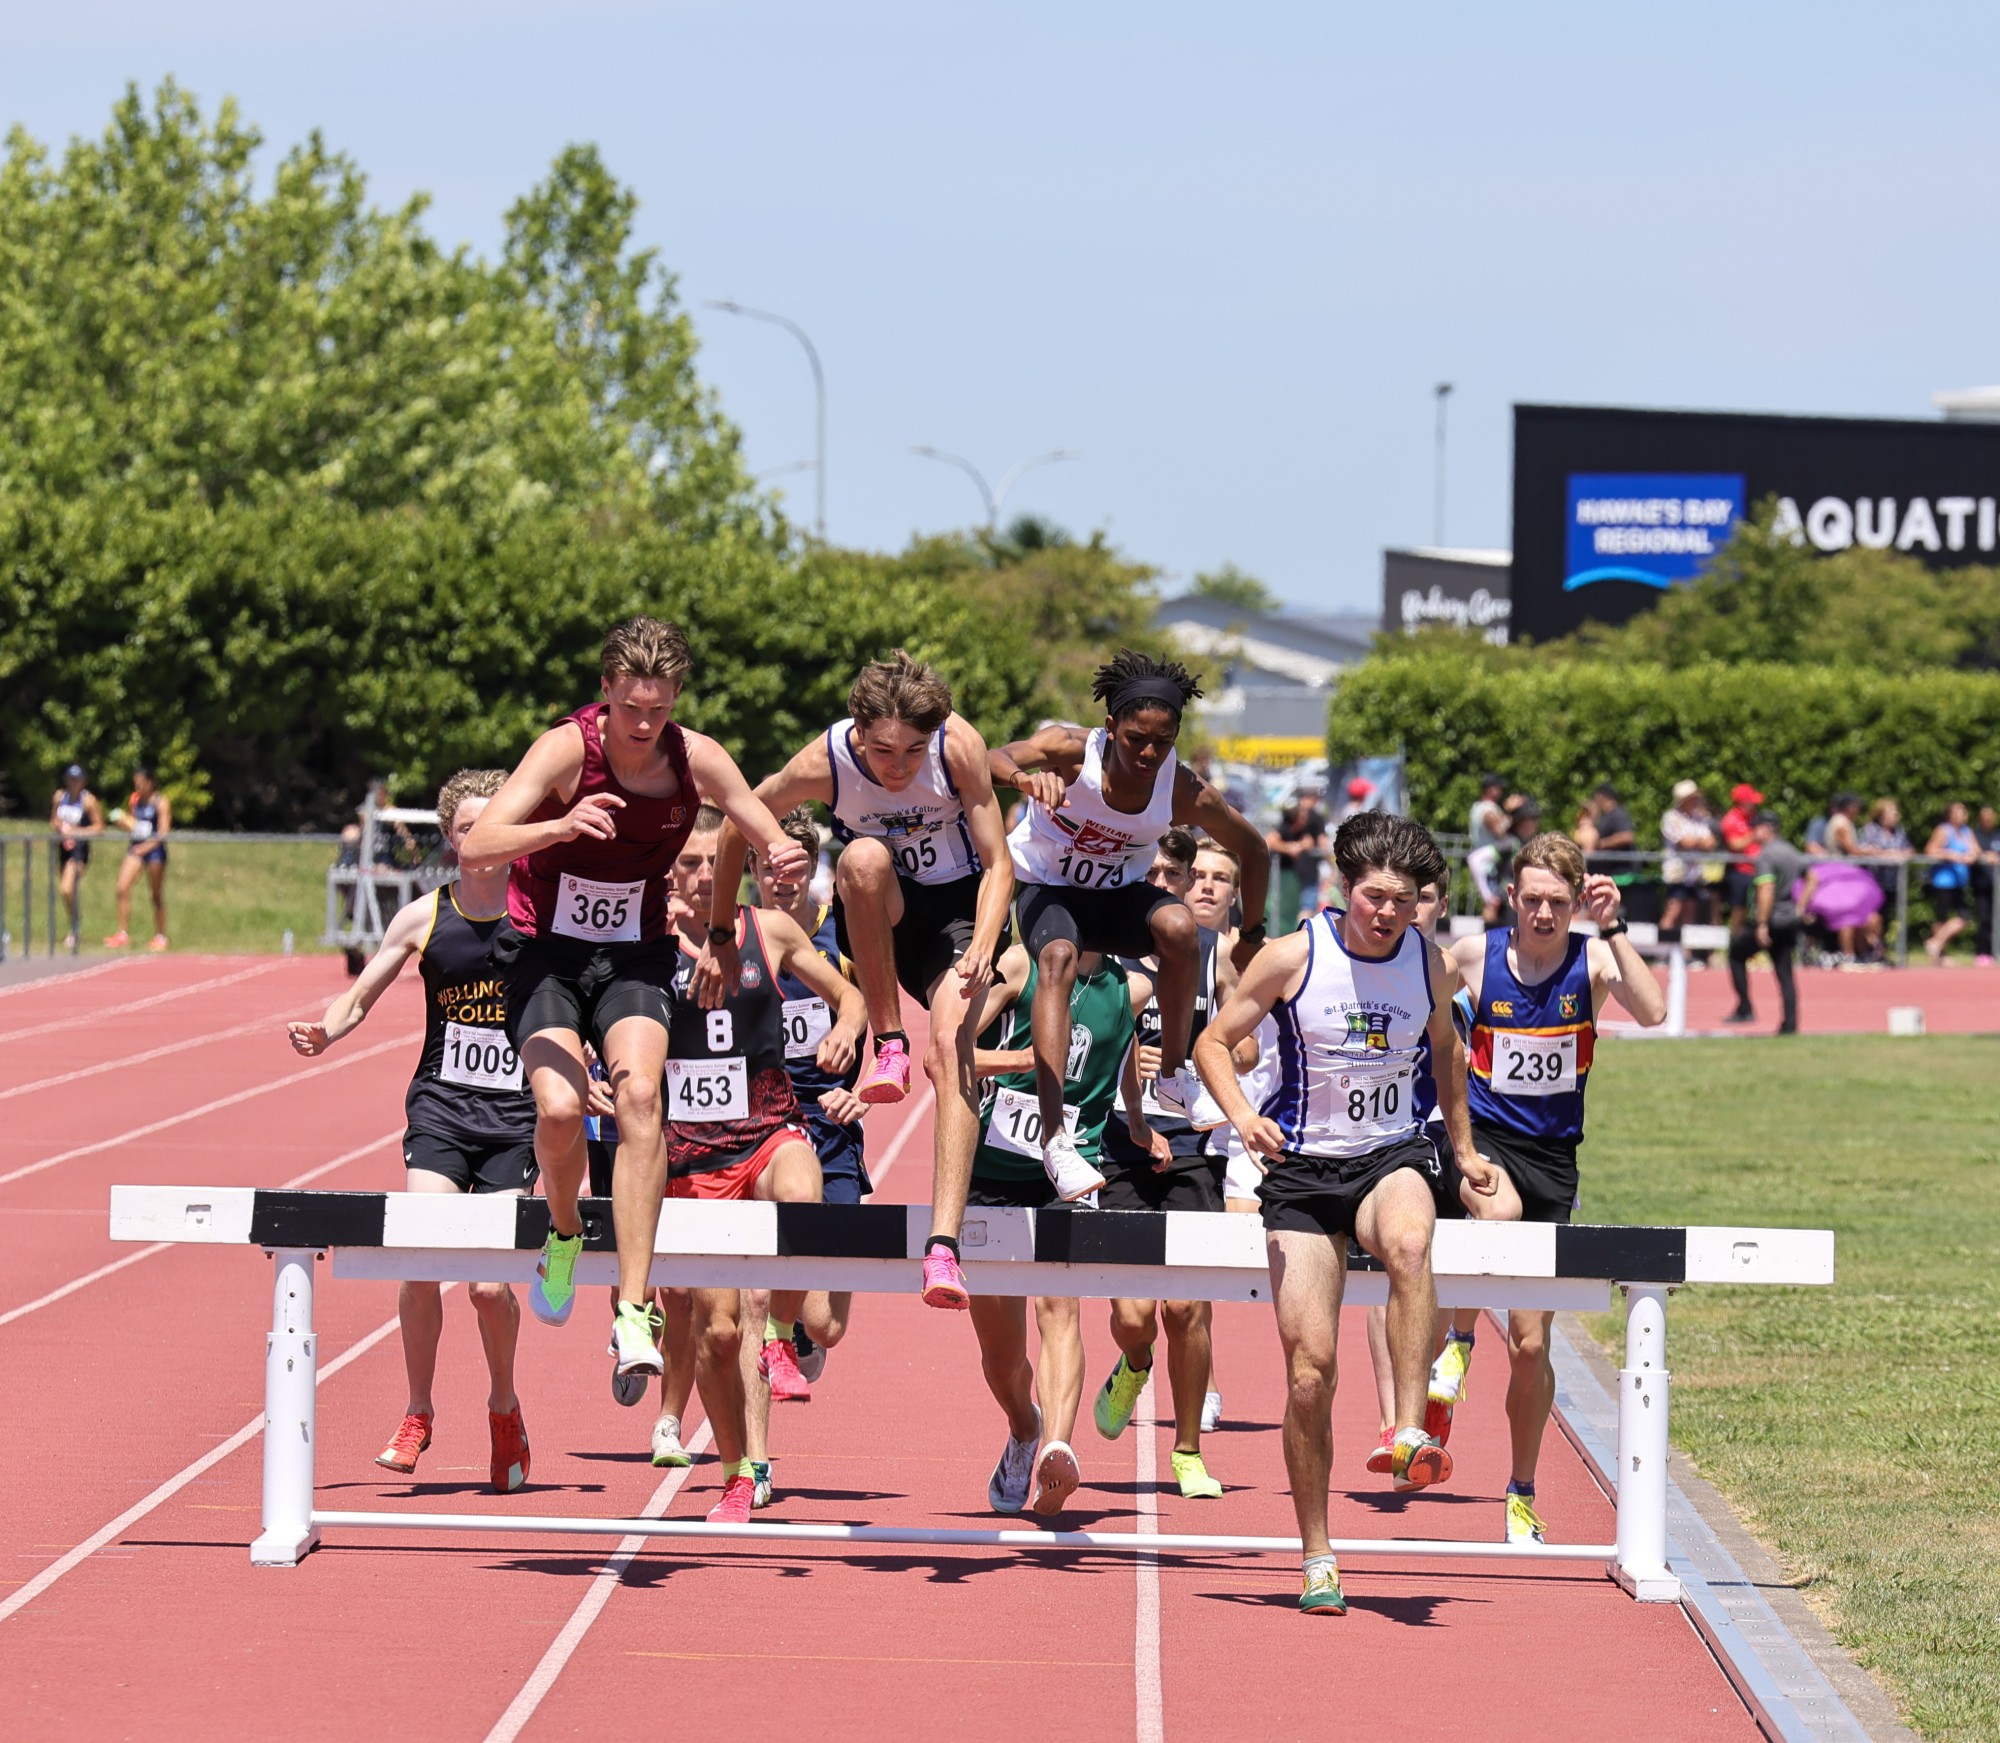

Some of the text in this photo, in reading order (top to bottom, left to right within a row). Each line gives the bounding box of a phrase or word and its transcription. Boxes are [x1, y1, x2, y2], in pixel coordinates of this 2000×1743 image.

[1769, 495, 2000, 551] AQUATI
[1593, 527, 1715, 555] REGIONAL
[1085, 818, 1134, 841] WESTLAKE
[570, 894, 630, 929] 365
[1381, 1003, 1412, 1020] College
[706, 1009, 734, 1052] 8
[450, 1040, 519, 1076] 1009
[1507, 1051, 1563, 1081] 239
[679, 1075, 733, 1107] 453
[1348, 1083, 1399, 1122] 810
